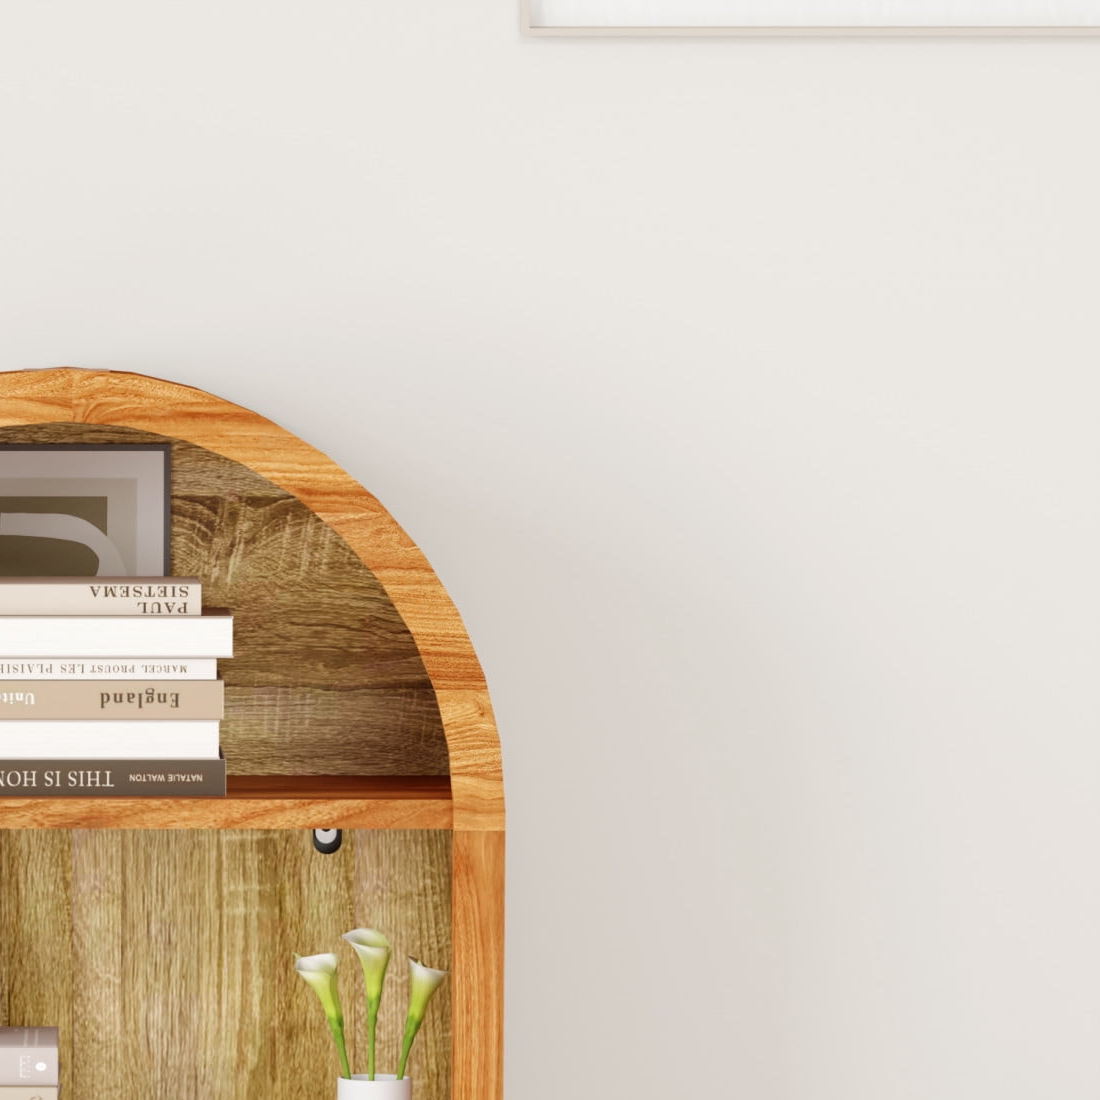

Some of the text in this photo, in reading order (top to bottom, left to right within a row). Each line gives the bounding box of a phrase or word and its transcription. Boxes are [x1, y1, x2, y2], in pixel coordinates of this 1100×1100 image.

[90, 585, 189, 598] SIETSEMA
[137, 602, 189, 614] PAUL
[60, 663, 85, 674] LES
[90, 664, 136, 673] PROUST
[140, 664, 188, 673] MARCEL
[99, 688, 181, 709] England
[44, 770, 62, 787] IS
[67, 770, 115, 787] THIS
[129, 773, 203, 782] NATALIE WALTON
